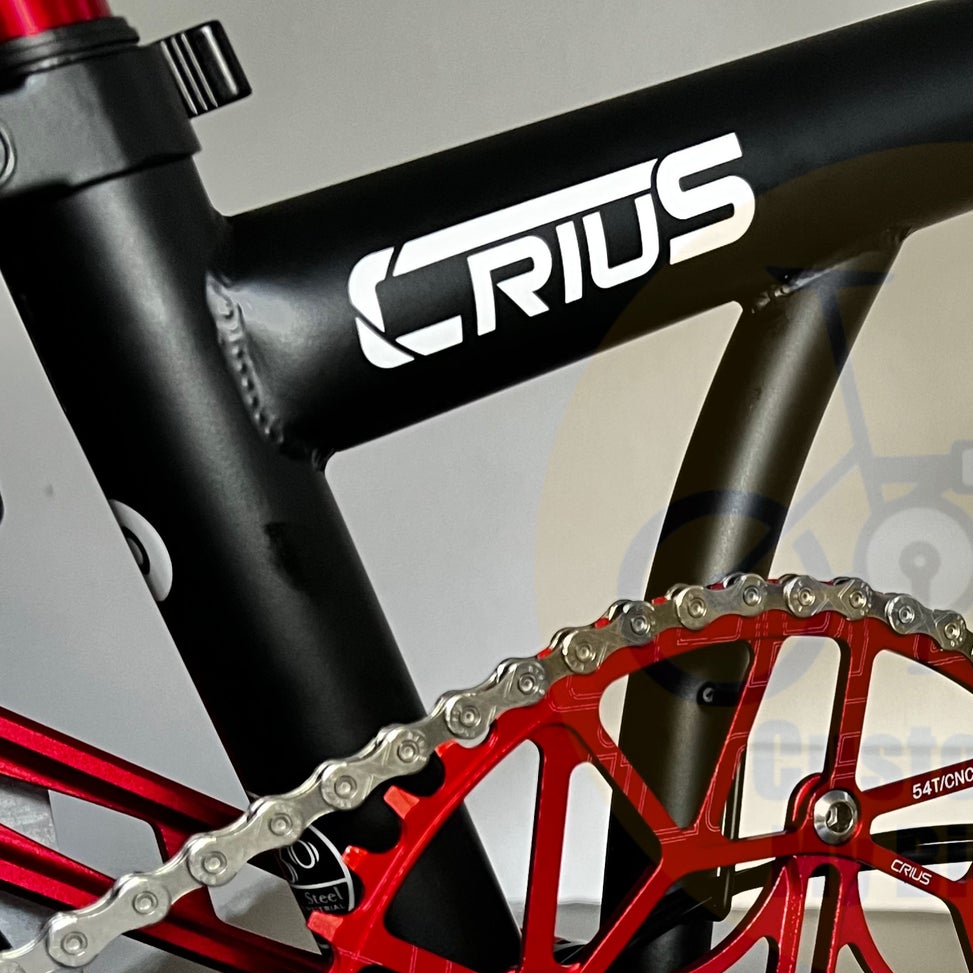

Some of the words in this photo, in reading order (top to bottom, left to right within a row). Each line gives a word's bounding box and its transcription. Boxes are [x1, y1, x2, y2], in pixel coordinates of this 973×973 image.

[348, 132, 756, 369] CRIUS
[890, 859, 932, 885] CRIUS
[304, 886, 344, 905] Steel
